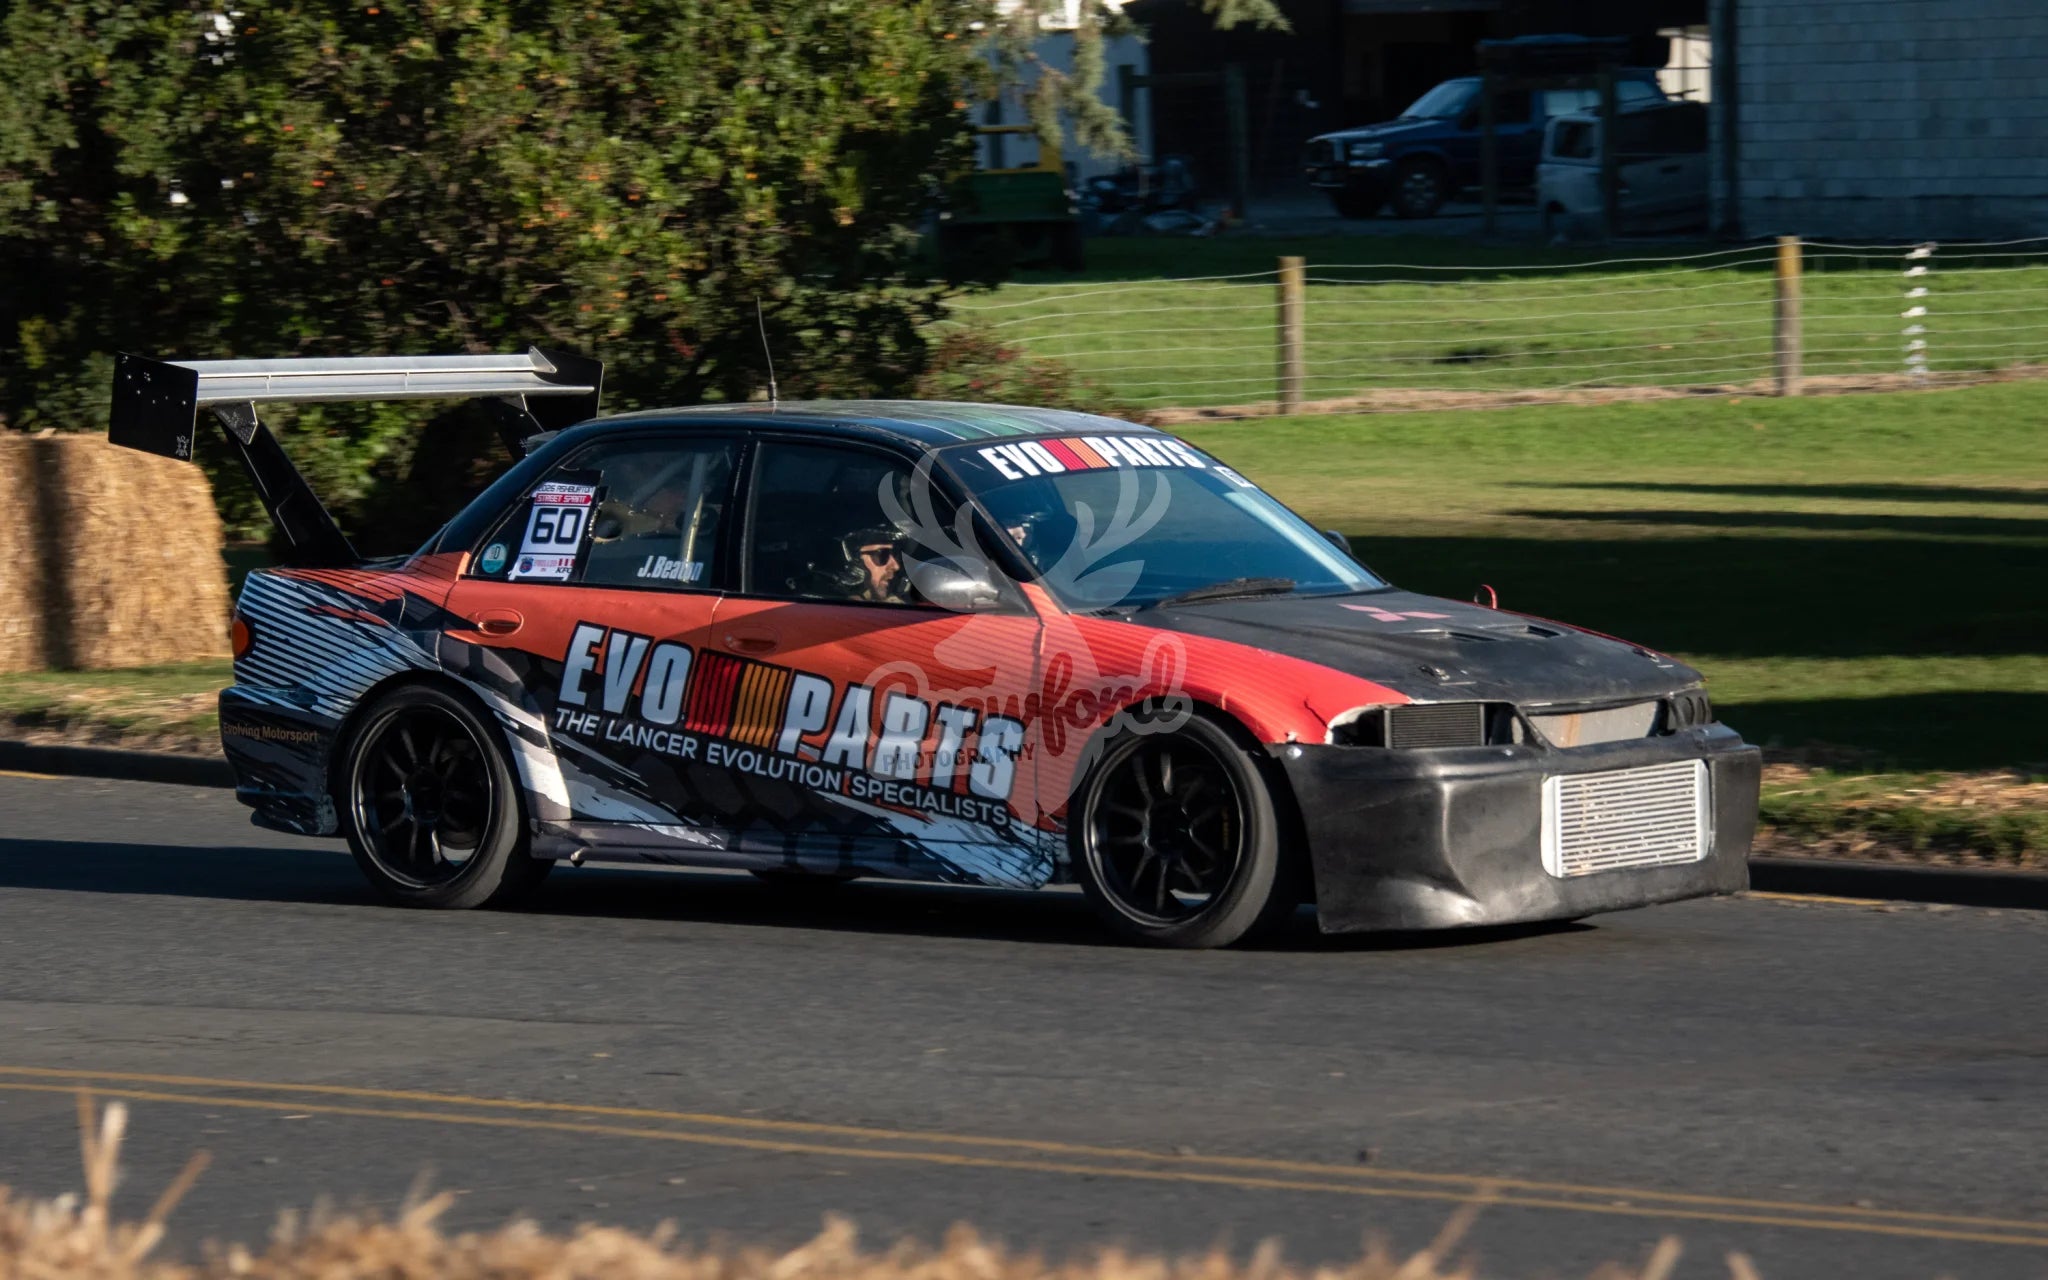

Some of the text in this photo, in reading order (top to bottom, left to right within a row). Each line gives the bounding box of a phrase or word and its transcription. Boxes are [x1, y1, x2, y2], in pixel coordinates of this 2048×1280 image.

[976, 436, 1206, 480] EVO PARTS
[537, 494, 586, 503] STREET SPRINT
[531, 507, 582, 544] 60
[558, 620, 1026, 798] EVO PARTS
[223, 722, 318, 744] Evolving Motorsport
[555, 707, 1008, 826] THE LANCER EVOLUTION SPECIALISTS
